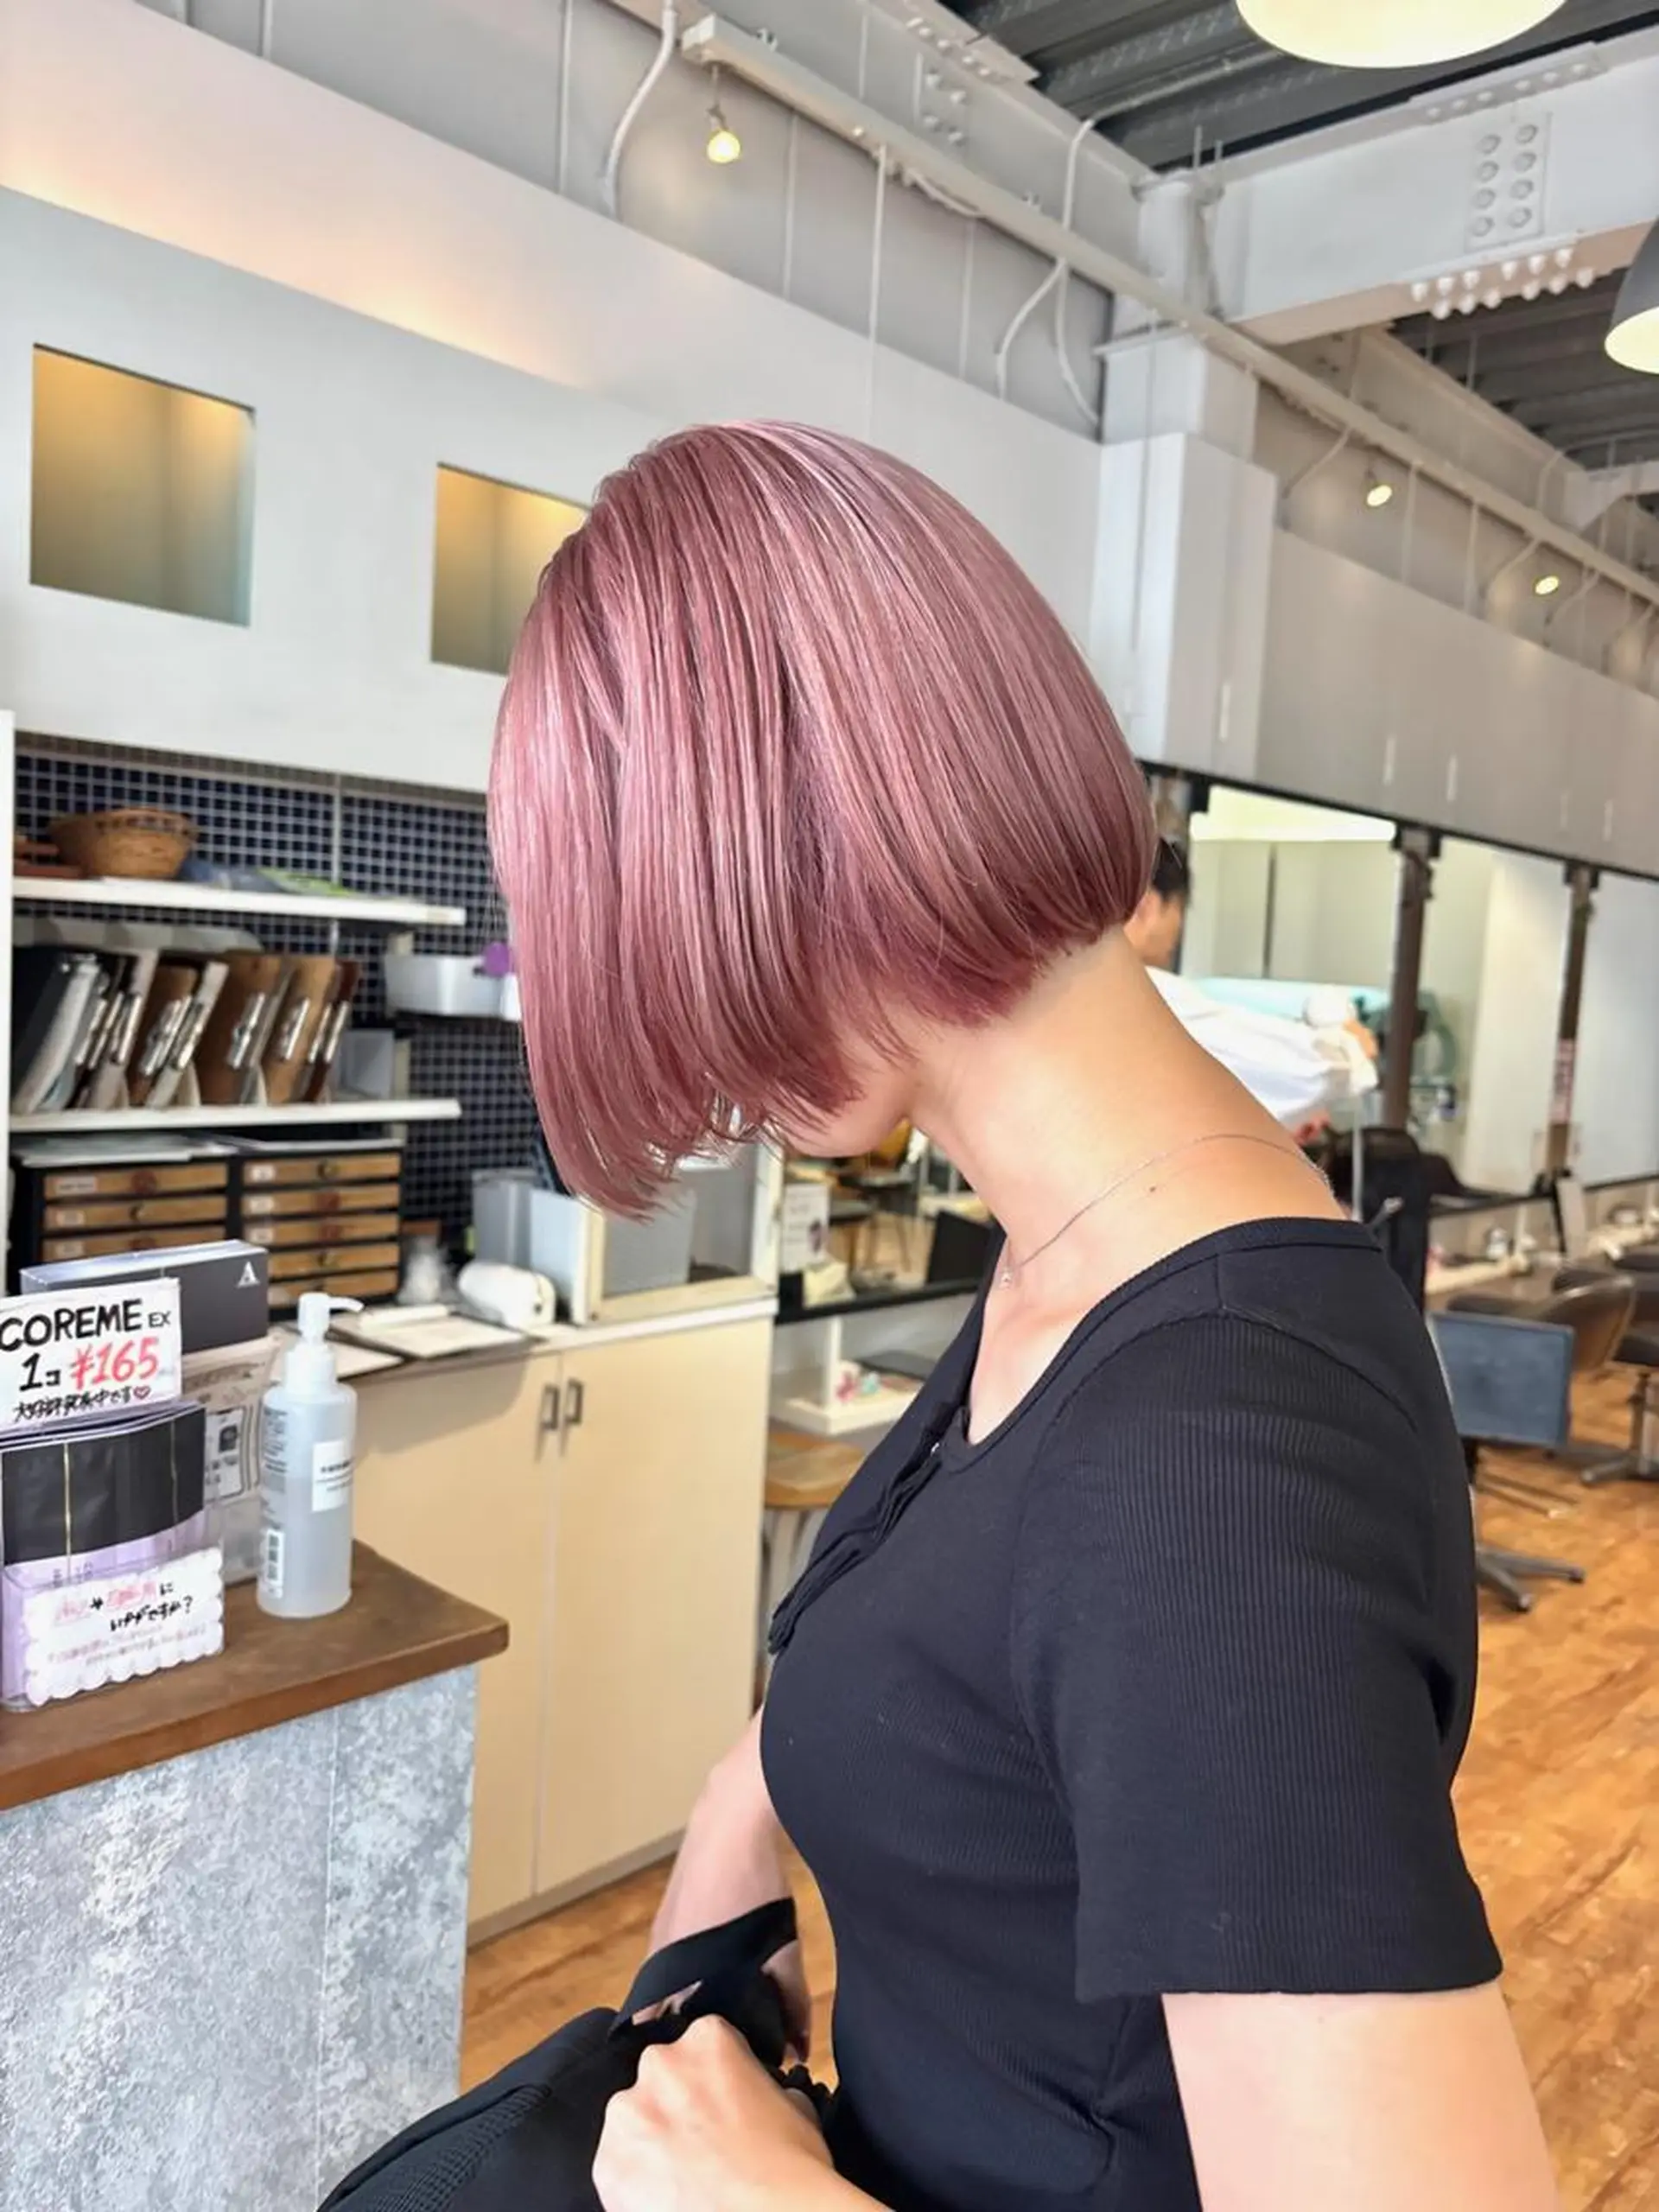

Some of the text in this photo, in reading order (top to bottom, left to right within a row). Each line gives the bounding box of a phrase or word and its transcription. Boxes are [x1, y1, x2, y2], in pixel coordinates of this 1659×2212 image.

[0, 1299, 171, 1351] COREME EX
[70, 1337, 159, 1390] ¥165
